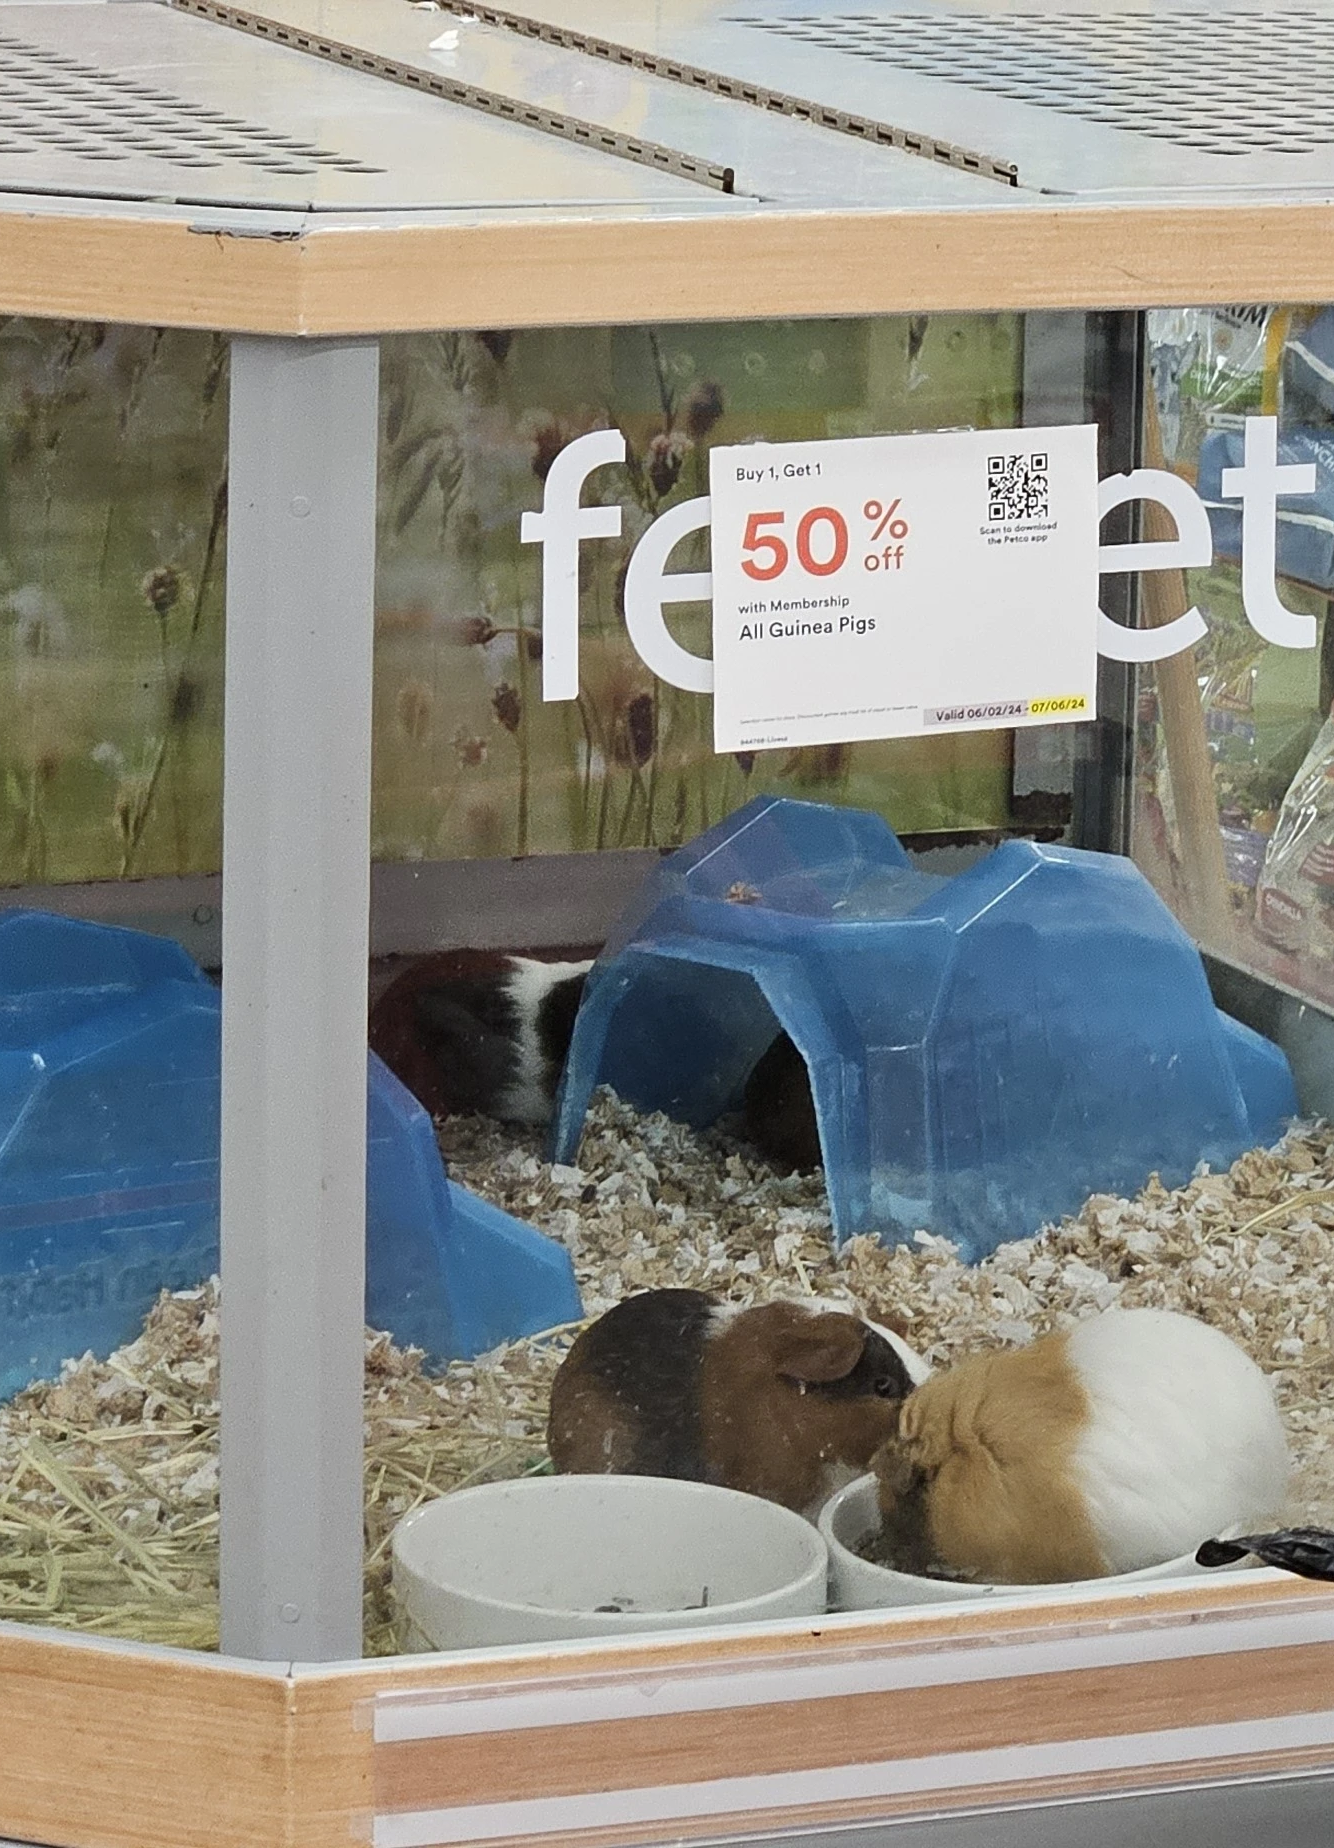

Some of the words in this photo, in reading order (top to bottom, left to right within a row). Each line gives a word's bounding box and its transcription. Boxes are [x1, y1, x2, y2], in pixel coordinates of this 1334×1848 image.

[736, 467, 764, 482] Buy
[768, 466, 779, 481] 1,
[783, 463, 811, 477] Get
[815, 462, 822, 476] 1
[979, 526, 1001, 535] Scan
[1014, 521, 1058, 532] download
[987, 537, 1002, 545] the
[1003, 535, 1029, 543] Petco
[1030, 534, 1048, 543] app
[740, 506, 849, 581] 50
[863, 499, 909, 541] %
[521, 416, 1318, 702] feet
[864, 545, 904, 571] off
[738, 601, 767, 614] with
[770, 595, 850, 613] Membership
[739, 623, 764, 641] All
[769, 619, 833, 638] Guinea
[839, 615, 877, 635] Pigs
[936, 708, 964, 721] Valid
[967, 704, 1022, 719] 06/02/24
[1031, 698, 1085, 713] 07/06/24
